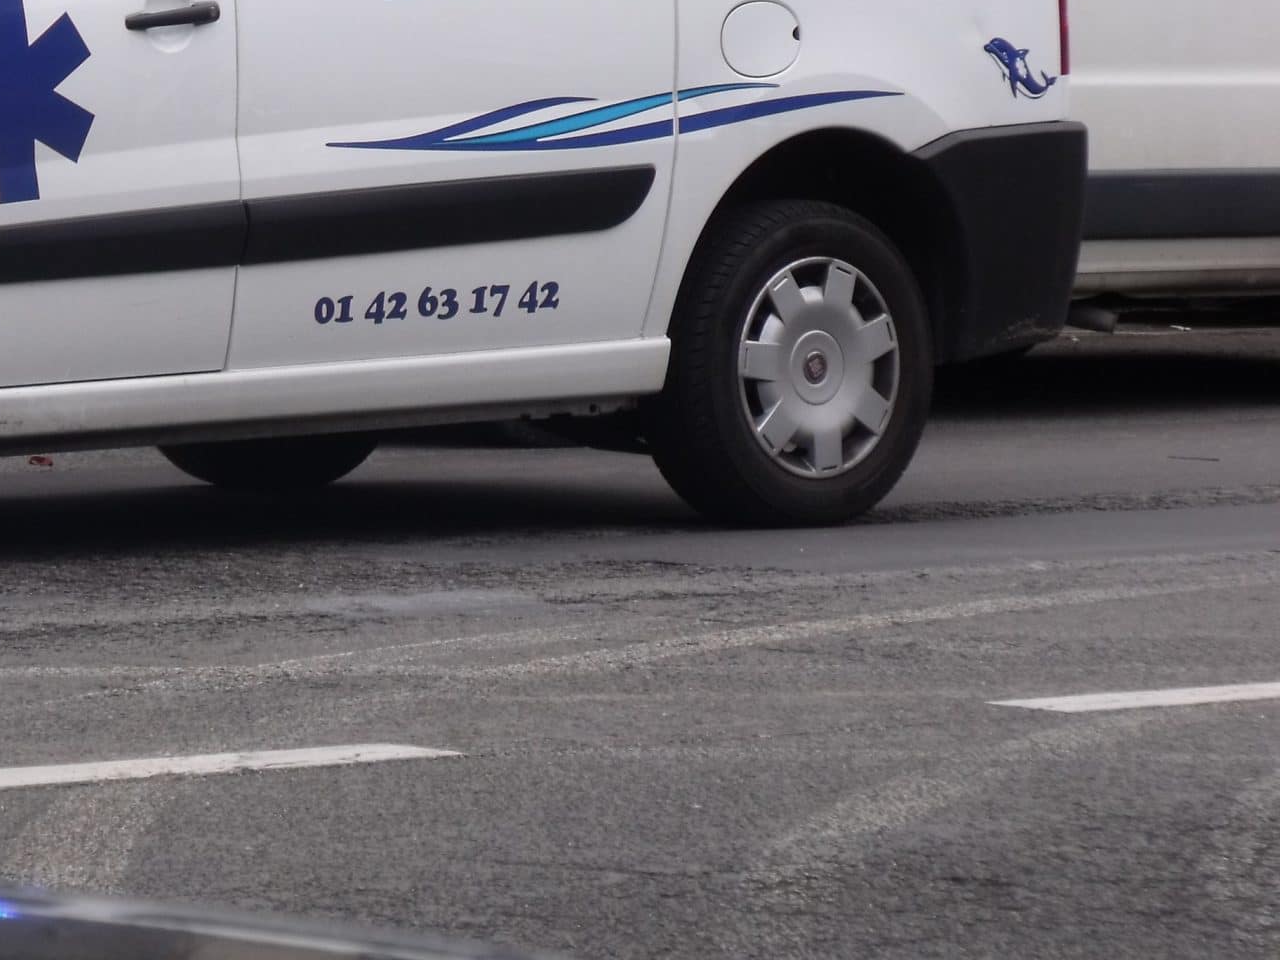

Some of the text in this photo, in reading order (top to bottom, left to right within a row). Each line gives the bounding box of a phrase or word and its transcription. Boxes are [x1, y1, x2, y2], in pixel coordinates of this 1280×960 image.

[314, 280, 559, 325] 01 42 63 17 42
